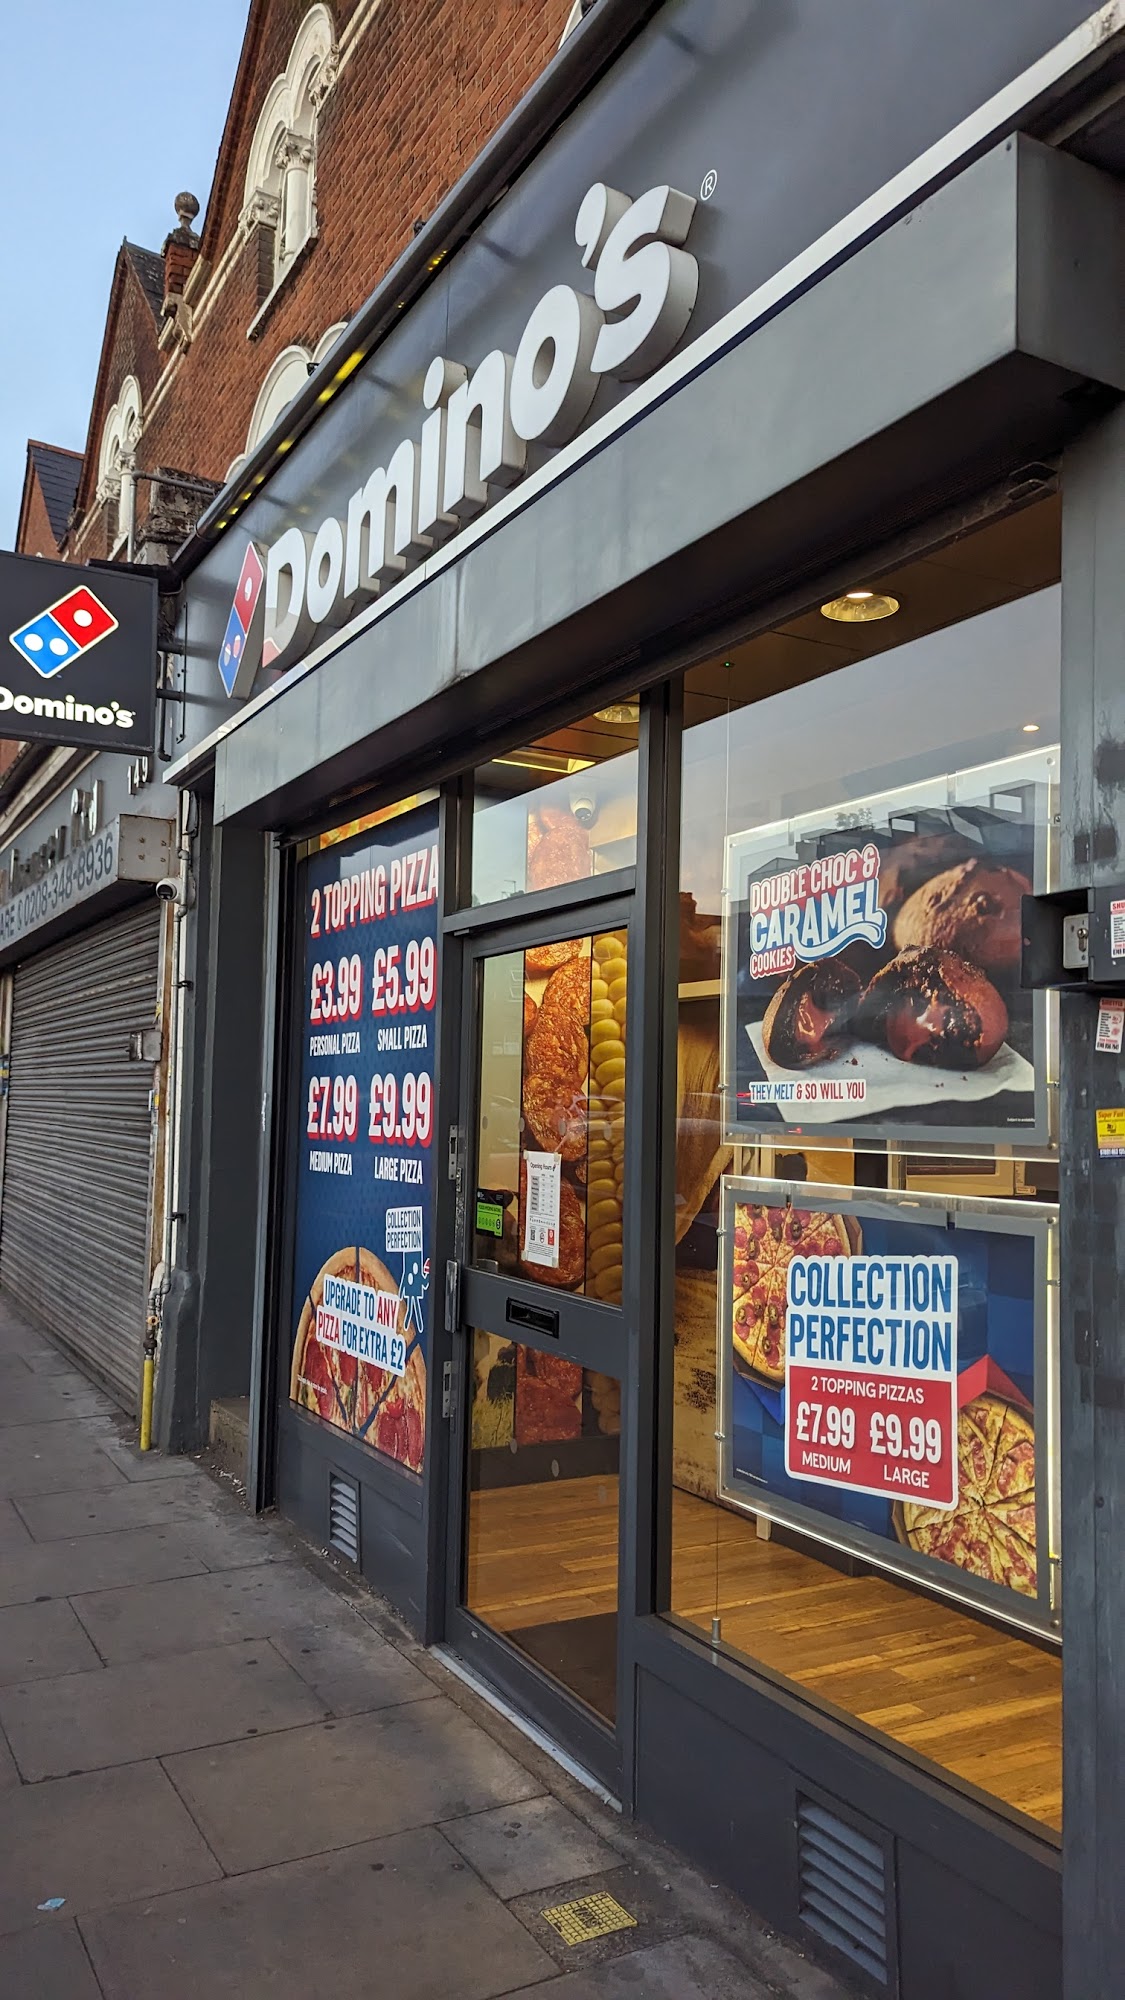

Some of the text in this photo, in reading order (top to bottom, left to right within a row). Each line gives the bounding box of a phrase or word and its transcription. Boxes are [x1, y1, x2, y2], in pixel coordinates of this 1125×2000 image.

[262, 183, 698, 668] Domino's
[127, 755, 148, 795] 149
[311, 844, 439, 935] 2 TOPPING PIZZA
[751, 845, 876, 913] DOUBLE CHOC &
[752, 879, 883, 956] CARAMEL
[310, 936, 435, 1020] £3.99 £5.99
[751, 946, 793, 975] COOKIES
[309, 1031, 361, 1057] PERSONAL PIZZA
[377, 1024, 428, 1052] SMALL PIZZA
[307, 1071, 431, 1140] £7.99 £9.99
[751, 1081, 865, 1100] THEY MELT & SO WILL YOU
[309, 1150, 353, 1176] MEDIUM PIZZA
[374, 1156, 423, 1185] LARGE PIZZA
[386, 1209, 421, 1229] COLLECTION
[386, 1230, 422, 1249] PERFECTION
[324, 1279, 397, 1329] UPGRADE TO ANY
[791, 1262, 952, 1313] COLLECTION
[317, 1311, 404, 1370] PIZZA FOR EXTRA £2
[789, 1313, 952, 1372] PERFECTION
[811, 1375, 925, 1404] 2 TOPPING PIZZAS
[796, 1401, 942, 1464] £7.99 £9.99
[802, 1450, 930, 1489] MEDIUM LARGE
